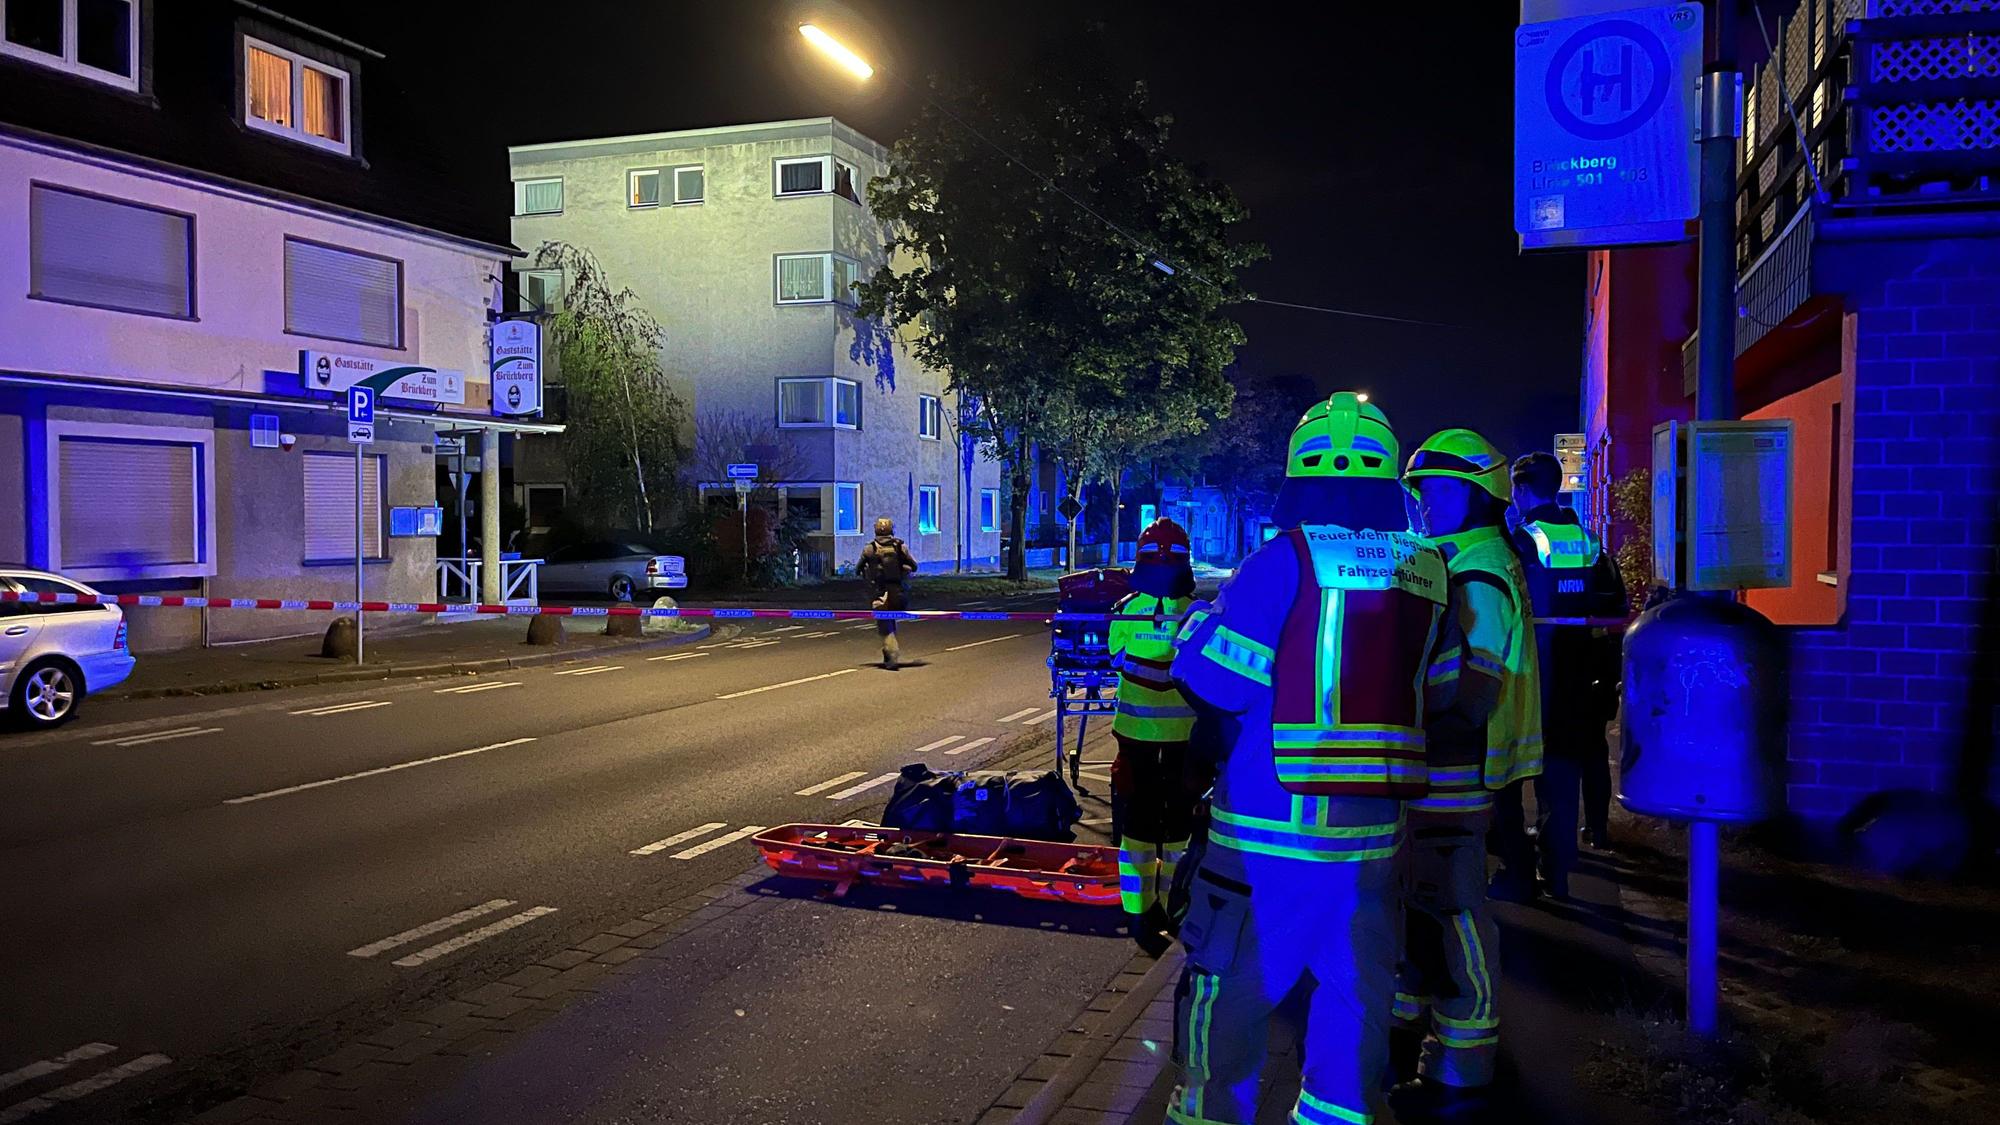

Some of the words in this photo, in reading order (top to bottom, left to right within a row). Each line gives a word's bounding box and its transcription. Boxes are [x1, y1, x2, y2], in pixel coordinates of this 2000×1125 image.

[1668, 9, 1689, 22] VRS
[1581, 44, 1632, 116] H
[1532, 176, 1570, 190] Lin
[1576, 172, 1603, 187] 501
[496, 345, 533, 355] Gaststätte
[335, 357, 374, 371] Gaststätte
[517, 360, 533, 370] Zum
[421, 373, 437, 385] Zum
[496, 370, 533, 382] Brückberg
[401, 382, 437, 398] Brückberg
[354, 390, 369, 418] P
[1309, 531, 1389, 542] Feuerwehr
[1356, 547, 1387, 559] BRB
[1552, 541, 1589, 555] POLIZEI
[1558, 579, 1585, 593] NRW
